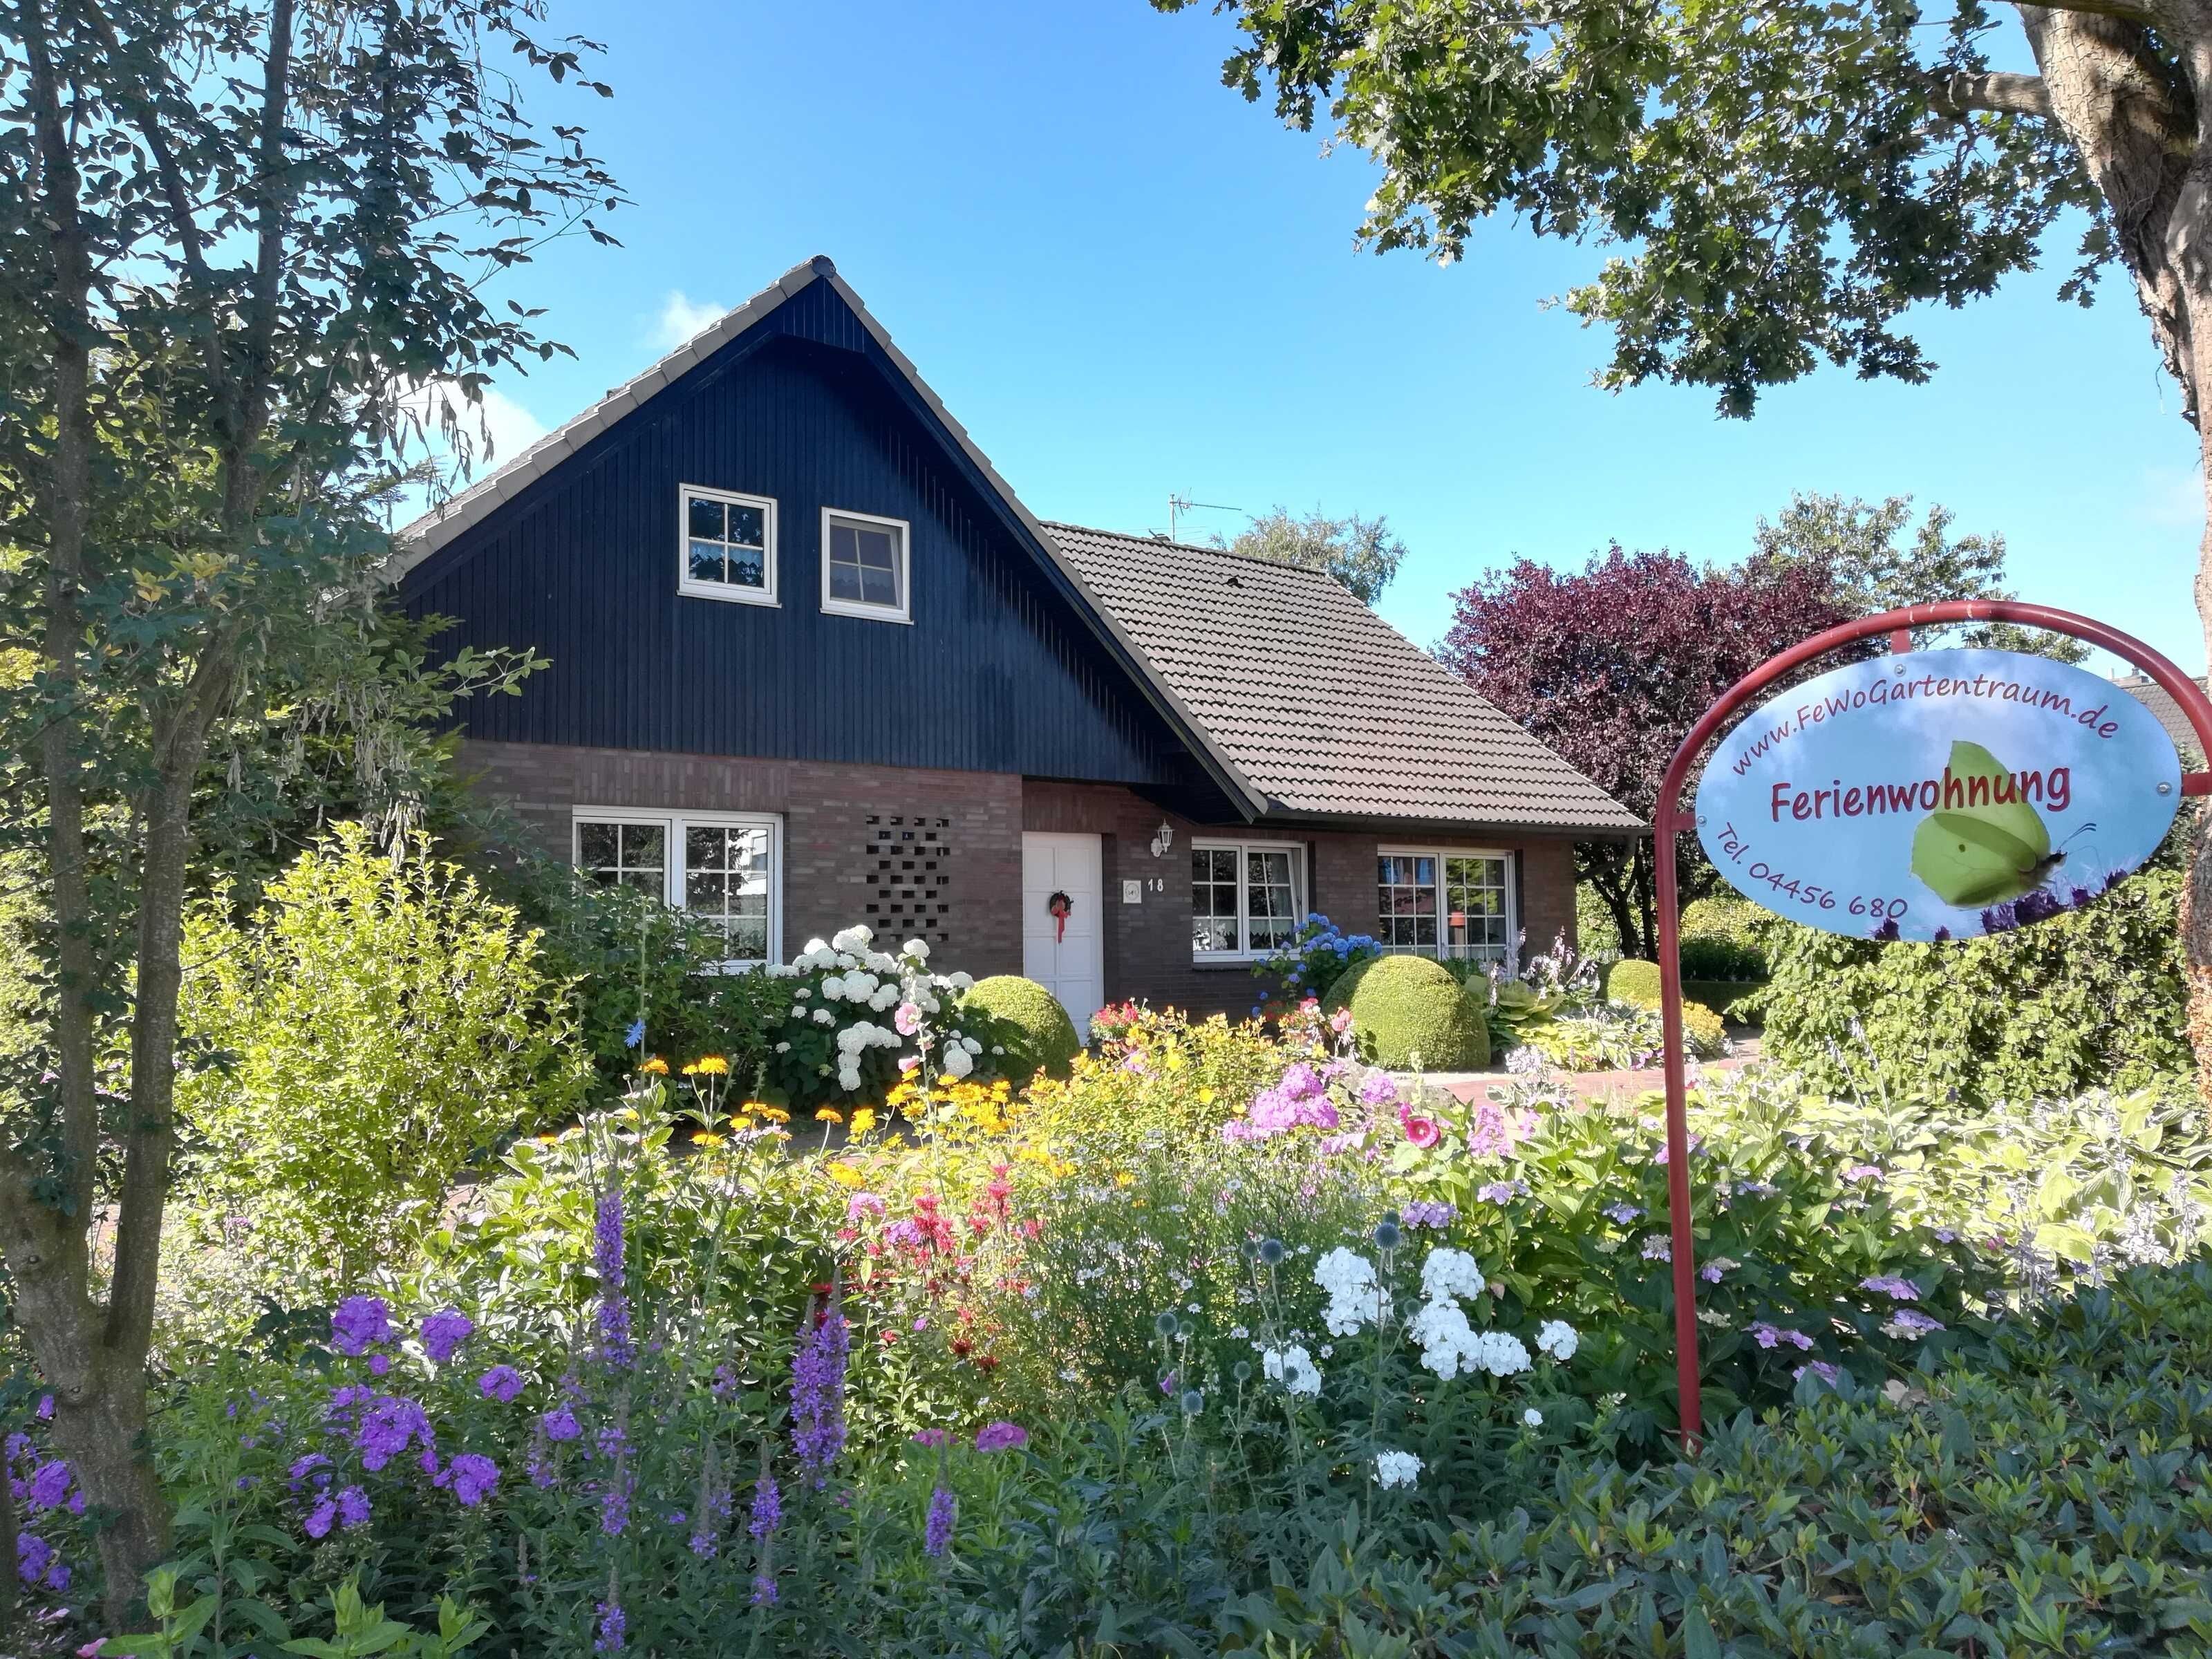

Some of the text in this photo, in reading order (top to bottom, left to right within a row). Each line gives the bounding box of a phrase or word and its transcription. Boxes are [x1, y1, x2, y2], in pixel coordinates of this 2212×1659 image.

[1732, 673, 2119, 776] www.FeWoGartentraum.de
[1771, 767, 2071, 823] Ferienwohnung
[1147, 879, 1163, 892] 18
[1718, 822, 1908, 919] Tel. 04456 680
